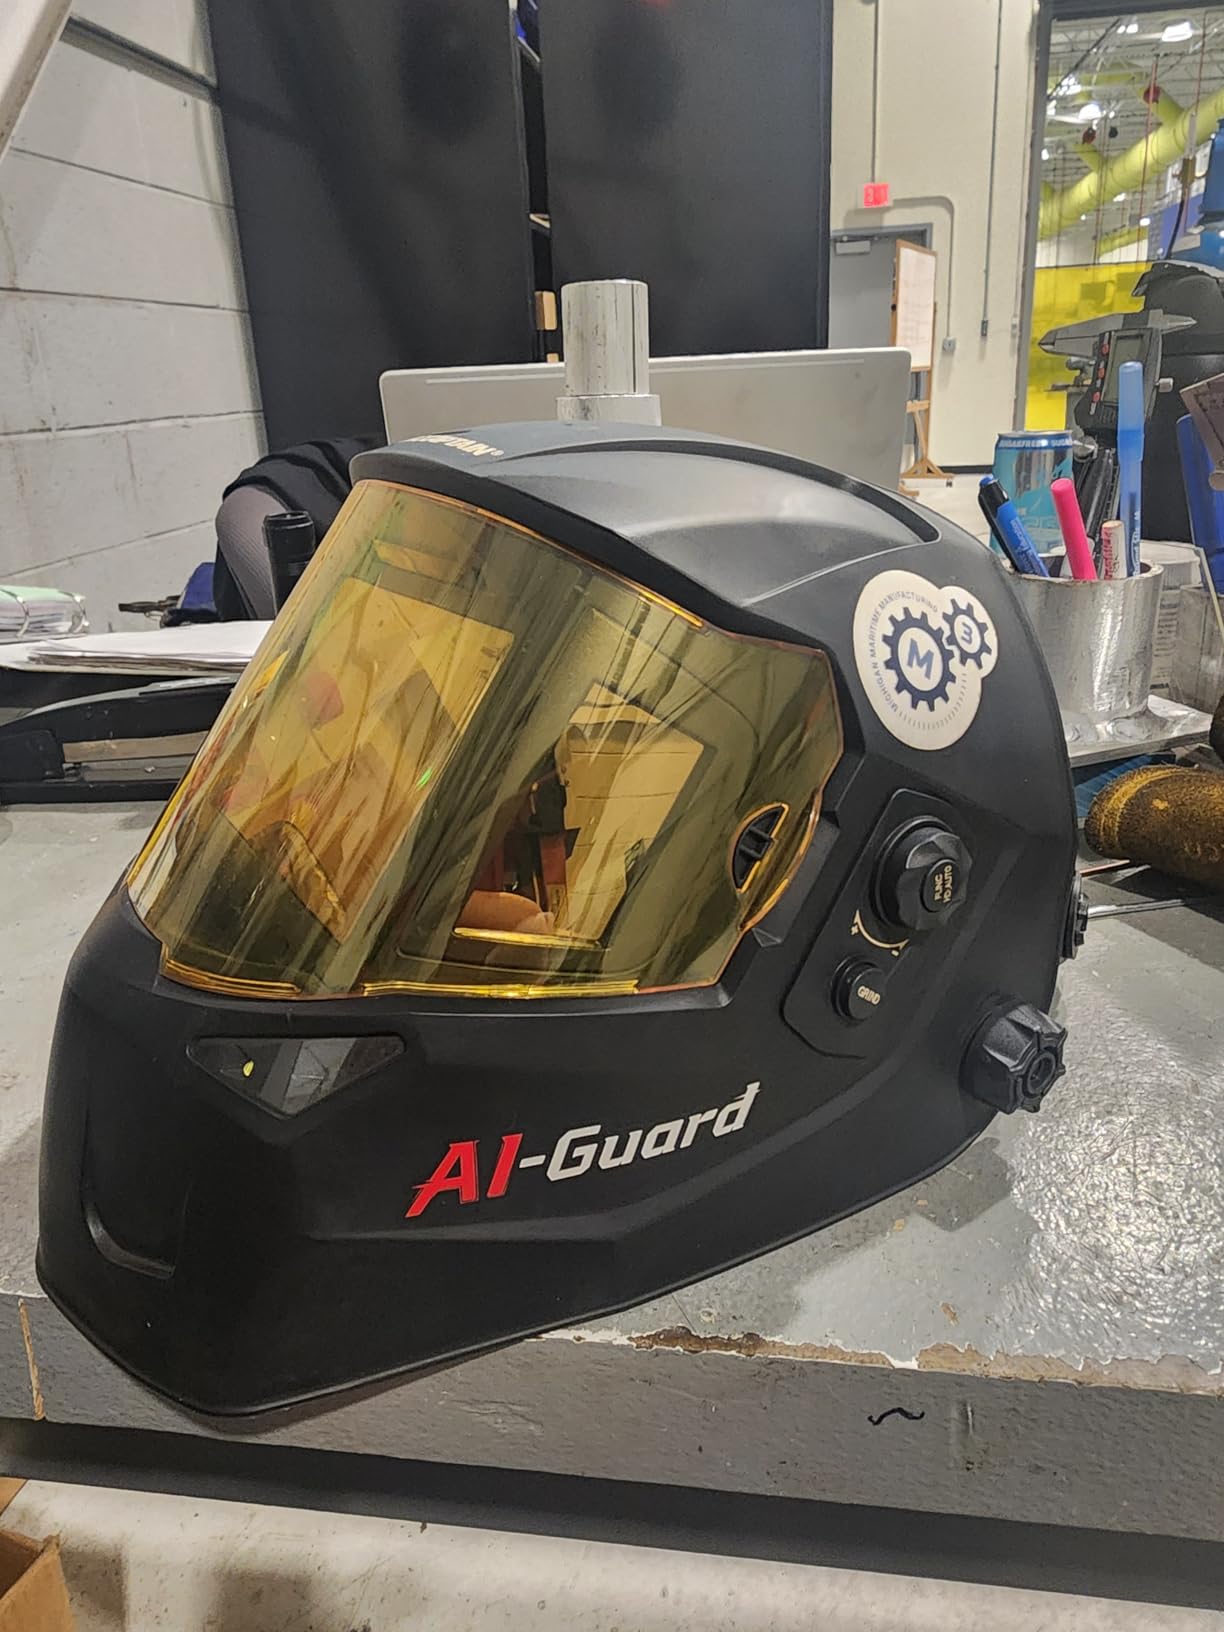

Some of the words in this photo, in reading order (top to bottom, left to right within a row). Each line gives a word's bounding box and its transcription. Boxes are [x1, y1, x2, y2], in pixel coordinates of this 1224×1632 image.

[878, 591, 938, 613] MANUFACTURING
[868, 608, 882, 658] MARITIME
[906, 638, 934, 680] M
[872, 662, 899, 712] MICHIGAN
[934, 874, 943, 900] FUNC
[944, 865, 953, 889] AUTO
[857, 985, 881, 1005] GRIND
[405, 1081, 760, 1218] AI-Guard
